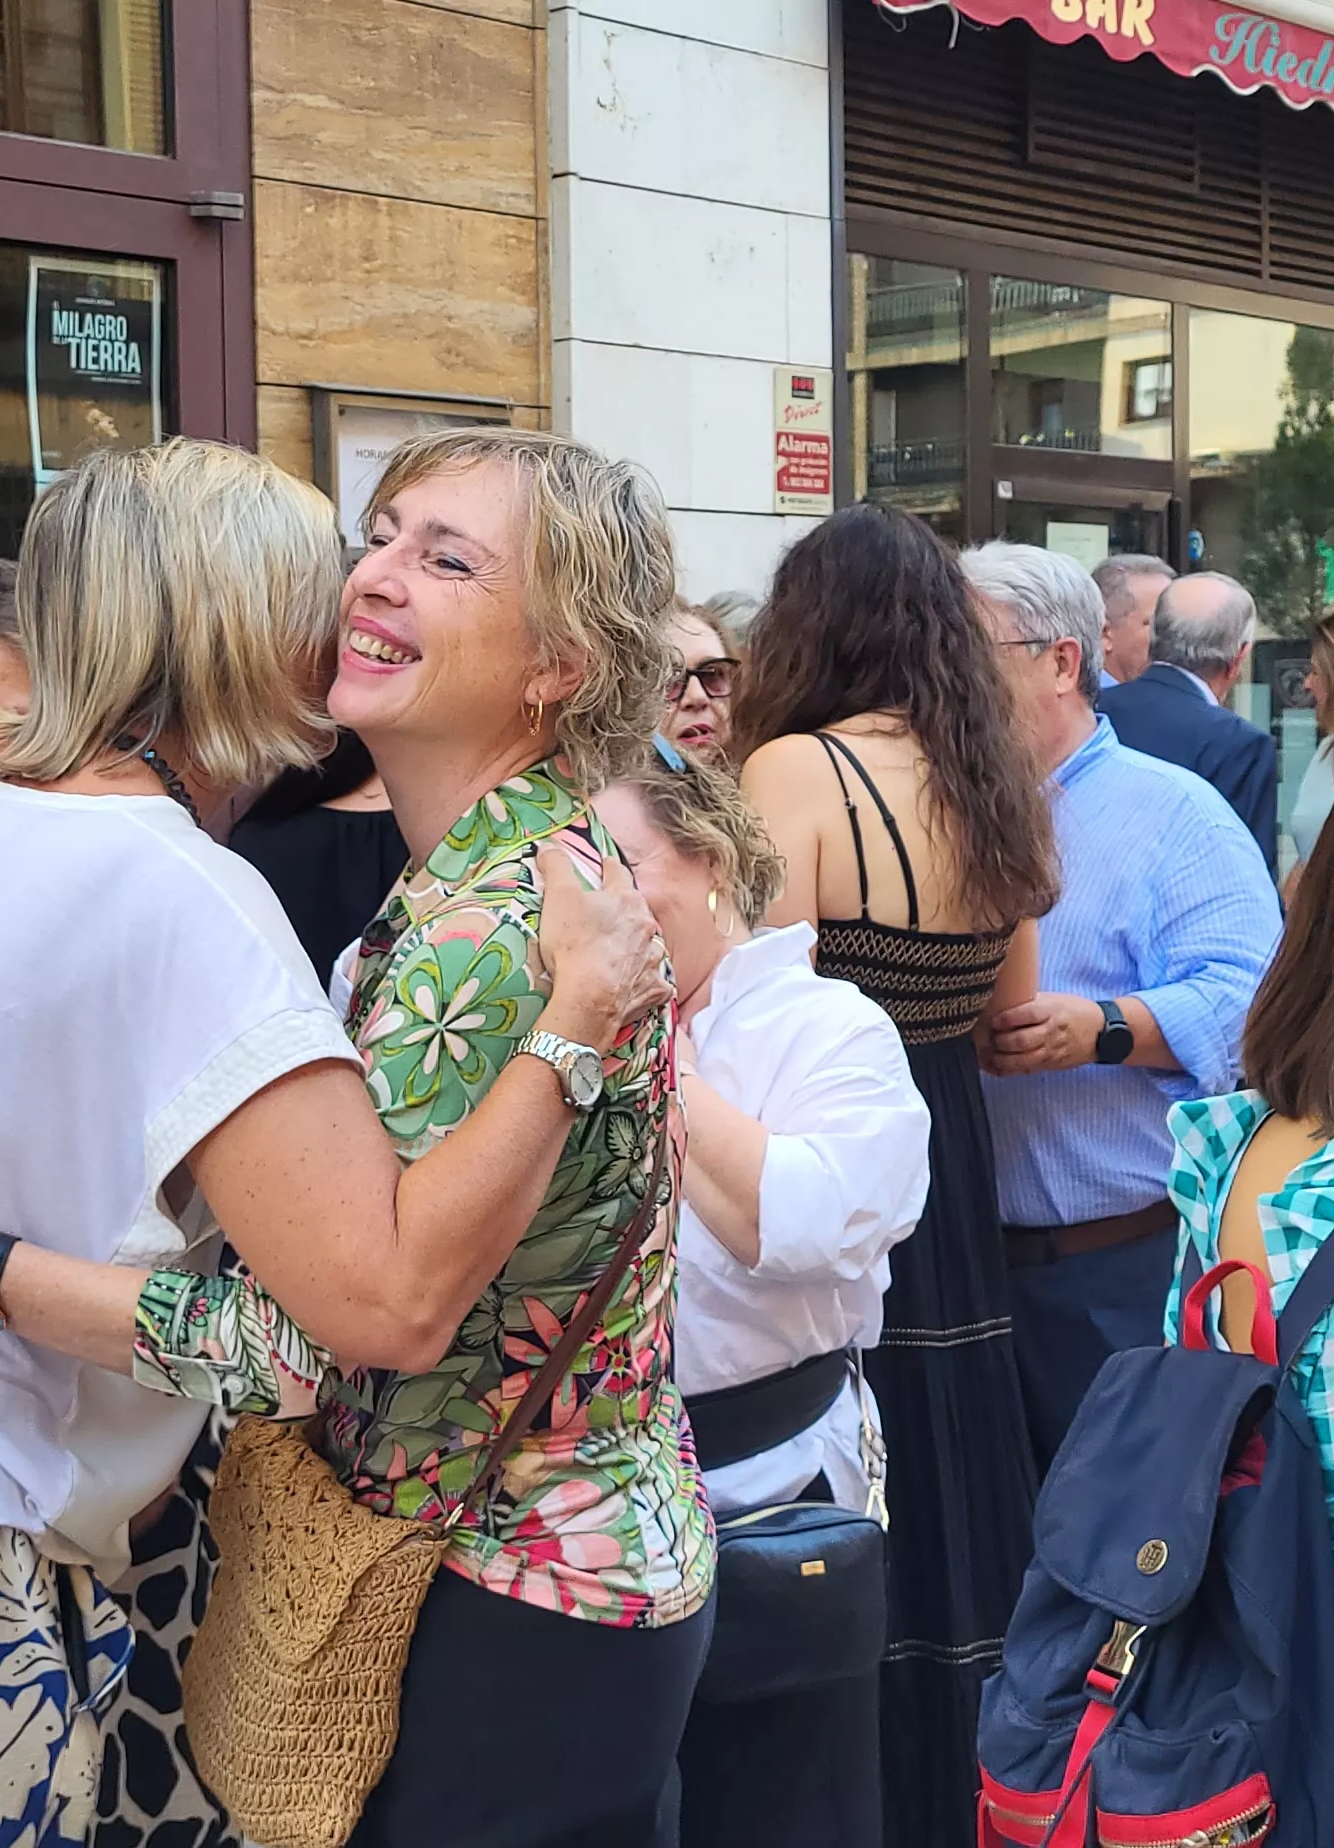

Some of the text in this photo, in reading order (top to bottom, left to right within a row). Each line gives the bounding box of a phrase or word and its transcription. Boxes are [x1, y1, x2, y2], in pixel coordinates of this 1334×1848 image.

[52, 310, 127, 340] MILAGRO
[68, 337, 142, 373] TIERRA
[778, 434, 829, 455] Alarma
